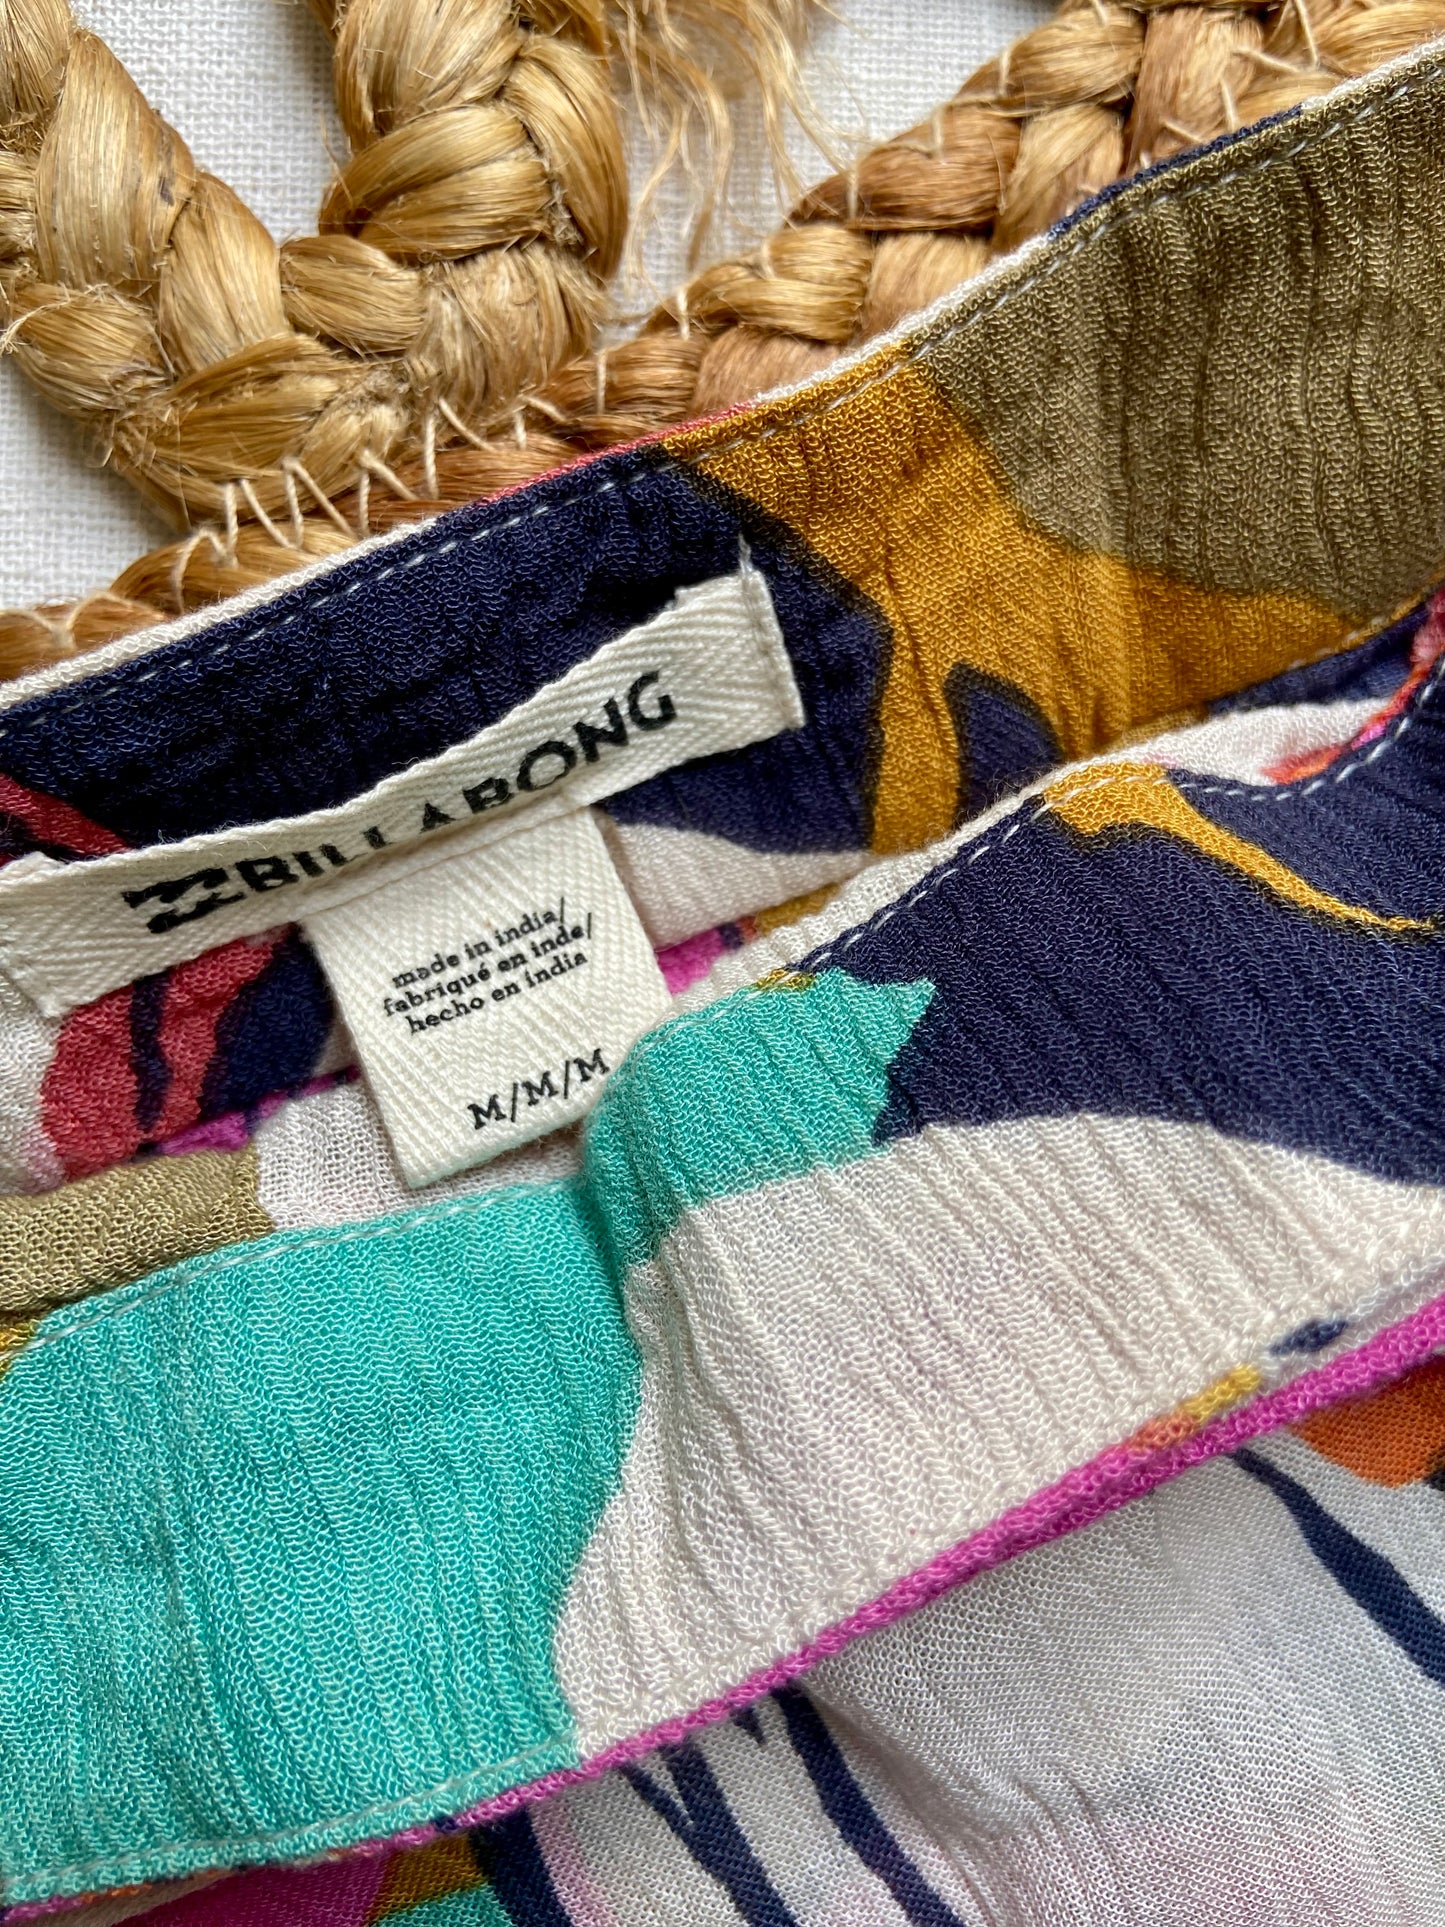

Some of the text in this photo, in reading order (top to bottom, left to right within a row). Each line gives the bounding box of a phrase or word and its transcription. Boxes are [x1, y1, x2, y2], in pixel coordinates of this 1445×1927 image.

[383, 911, 593, 1017] fabriqué en inde/
[391, 896, 565, 989] made in india/
[405, 952, 588, 1034] hecho en india
[467, 1048, 610, 1130] M/M/M
